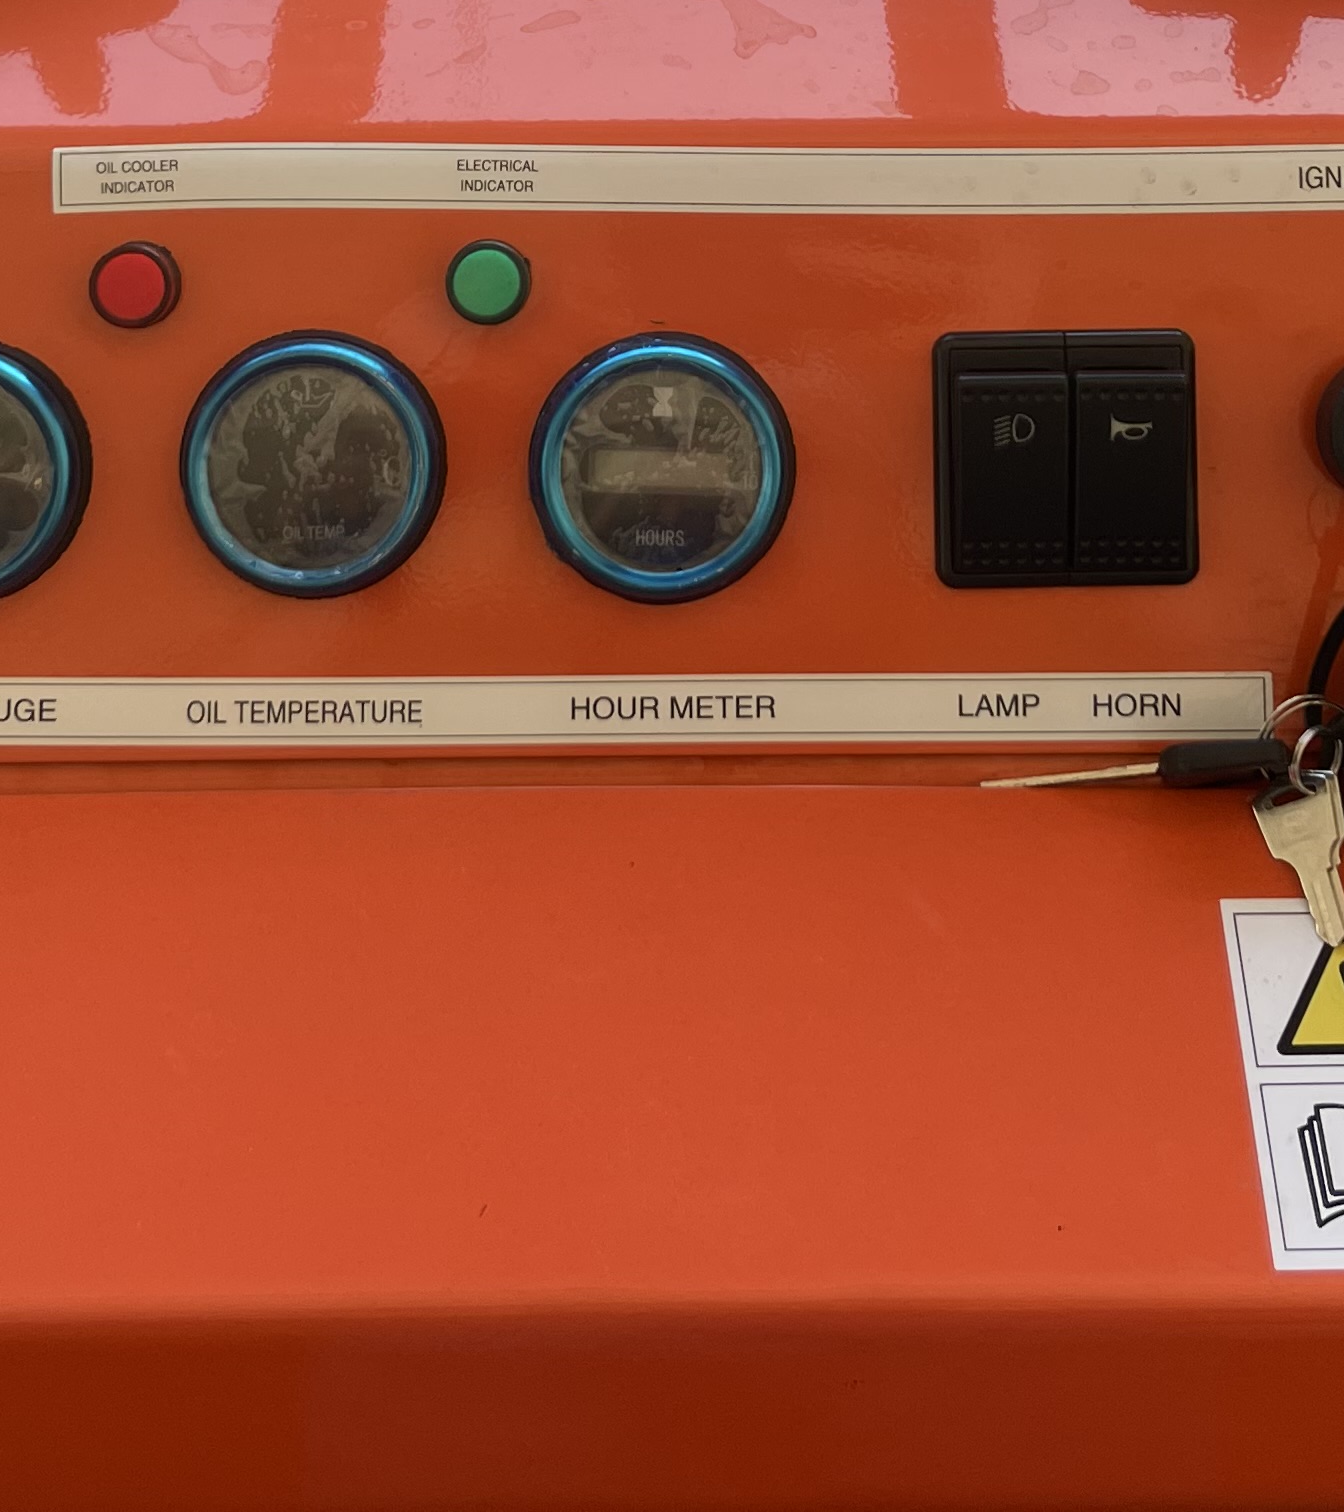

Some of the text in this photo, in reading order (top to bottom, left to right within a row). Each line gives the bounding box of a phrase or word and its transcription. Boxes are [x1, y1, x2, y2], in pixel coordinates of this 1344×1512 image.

[95, 159, 180, 176] OIL COOLER
[455, 159, 540, 174] ELECTRICAL
[99, 179, 176, 195] INDICATOR
[459, 179, 535, 194] INDICATOR
[282, 525, 346, 540] OIL TEMP
[634, 529, 685, 547] HOURS
[185, 699, 423, 725] OIL TEMPERATURE
[570, 695, 776, 721] HOUR METER
[957, 692, 1041, 718] LAMP
[1092, 692, 1182, 718] HORN
